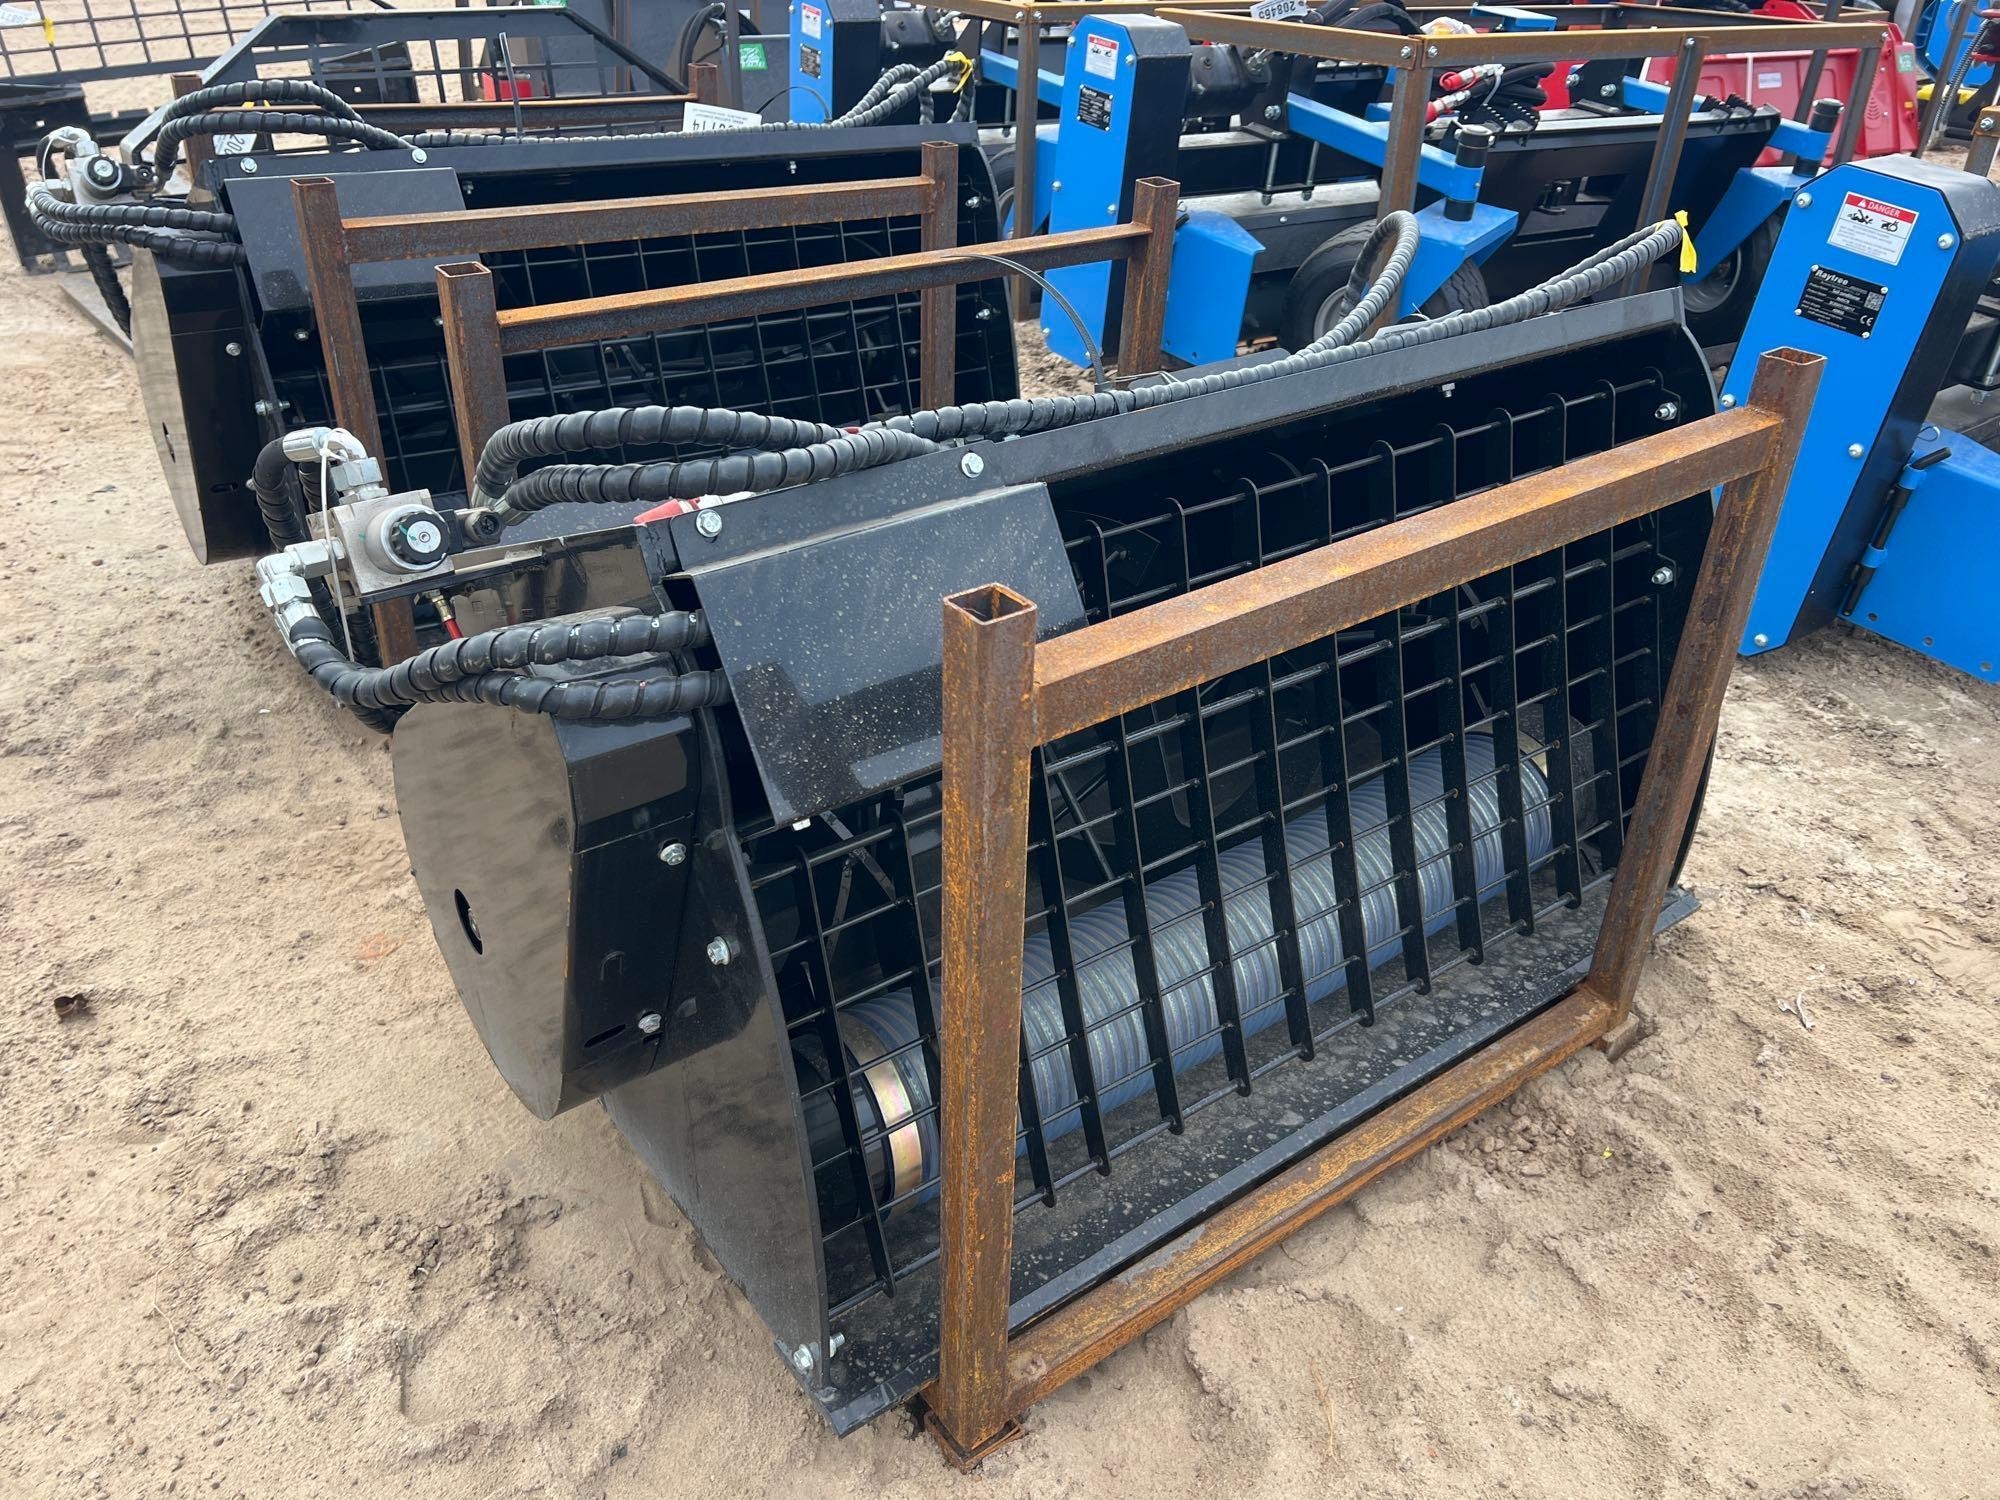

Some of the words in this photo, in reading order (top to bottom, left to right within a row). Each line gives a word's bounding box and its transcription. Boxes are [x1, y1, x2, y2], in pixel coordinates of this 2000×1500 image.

[1867, 201, 1901, 218] DANGER
[1814, 268, 1849, 286] Raytree
[1860, 315, 1874, 327] CE
